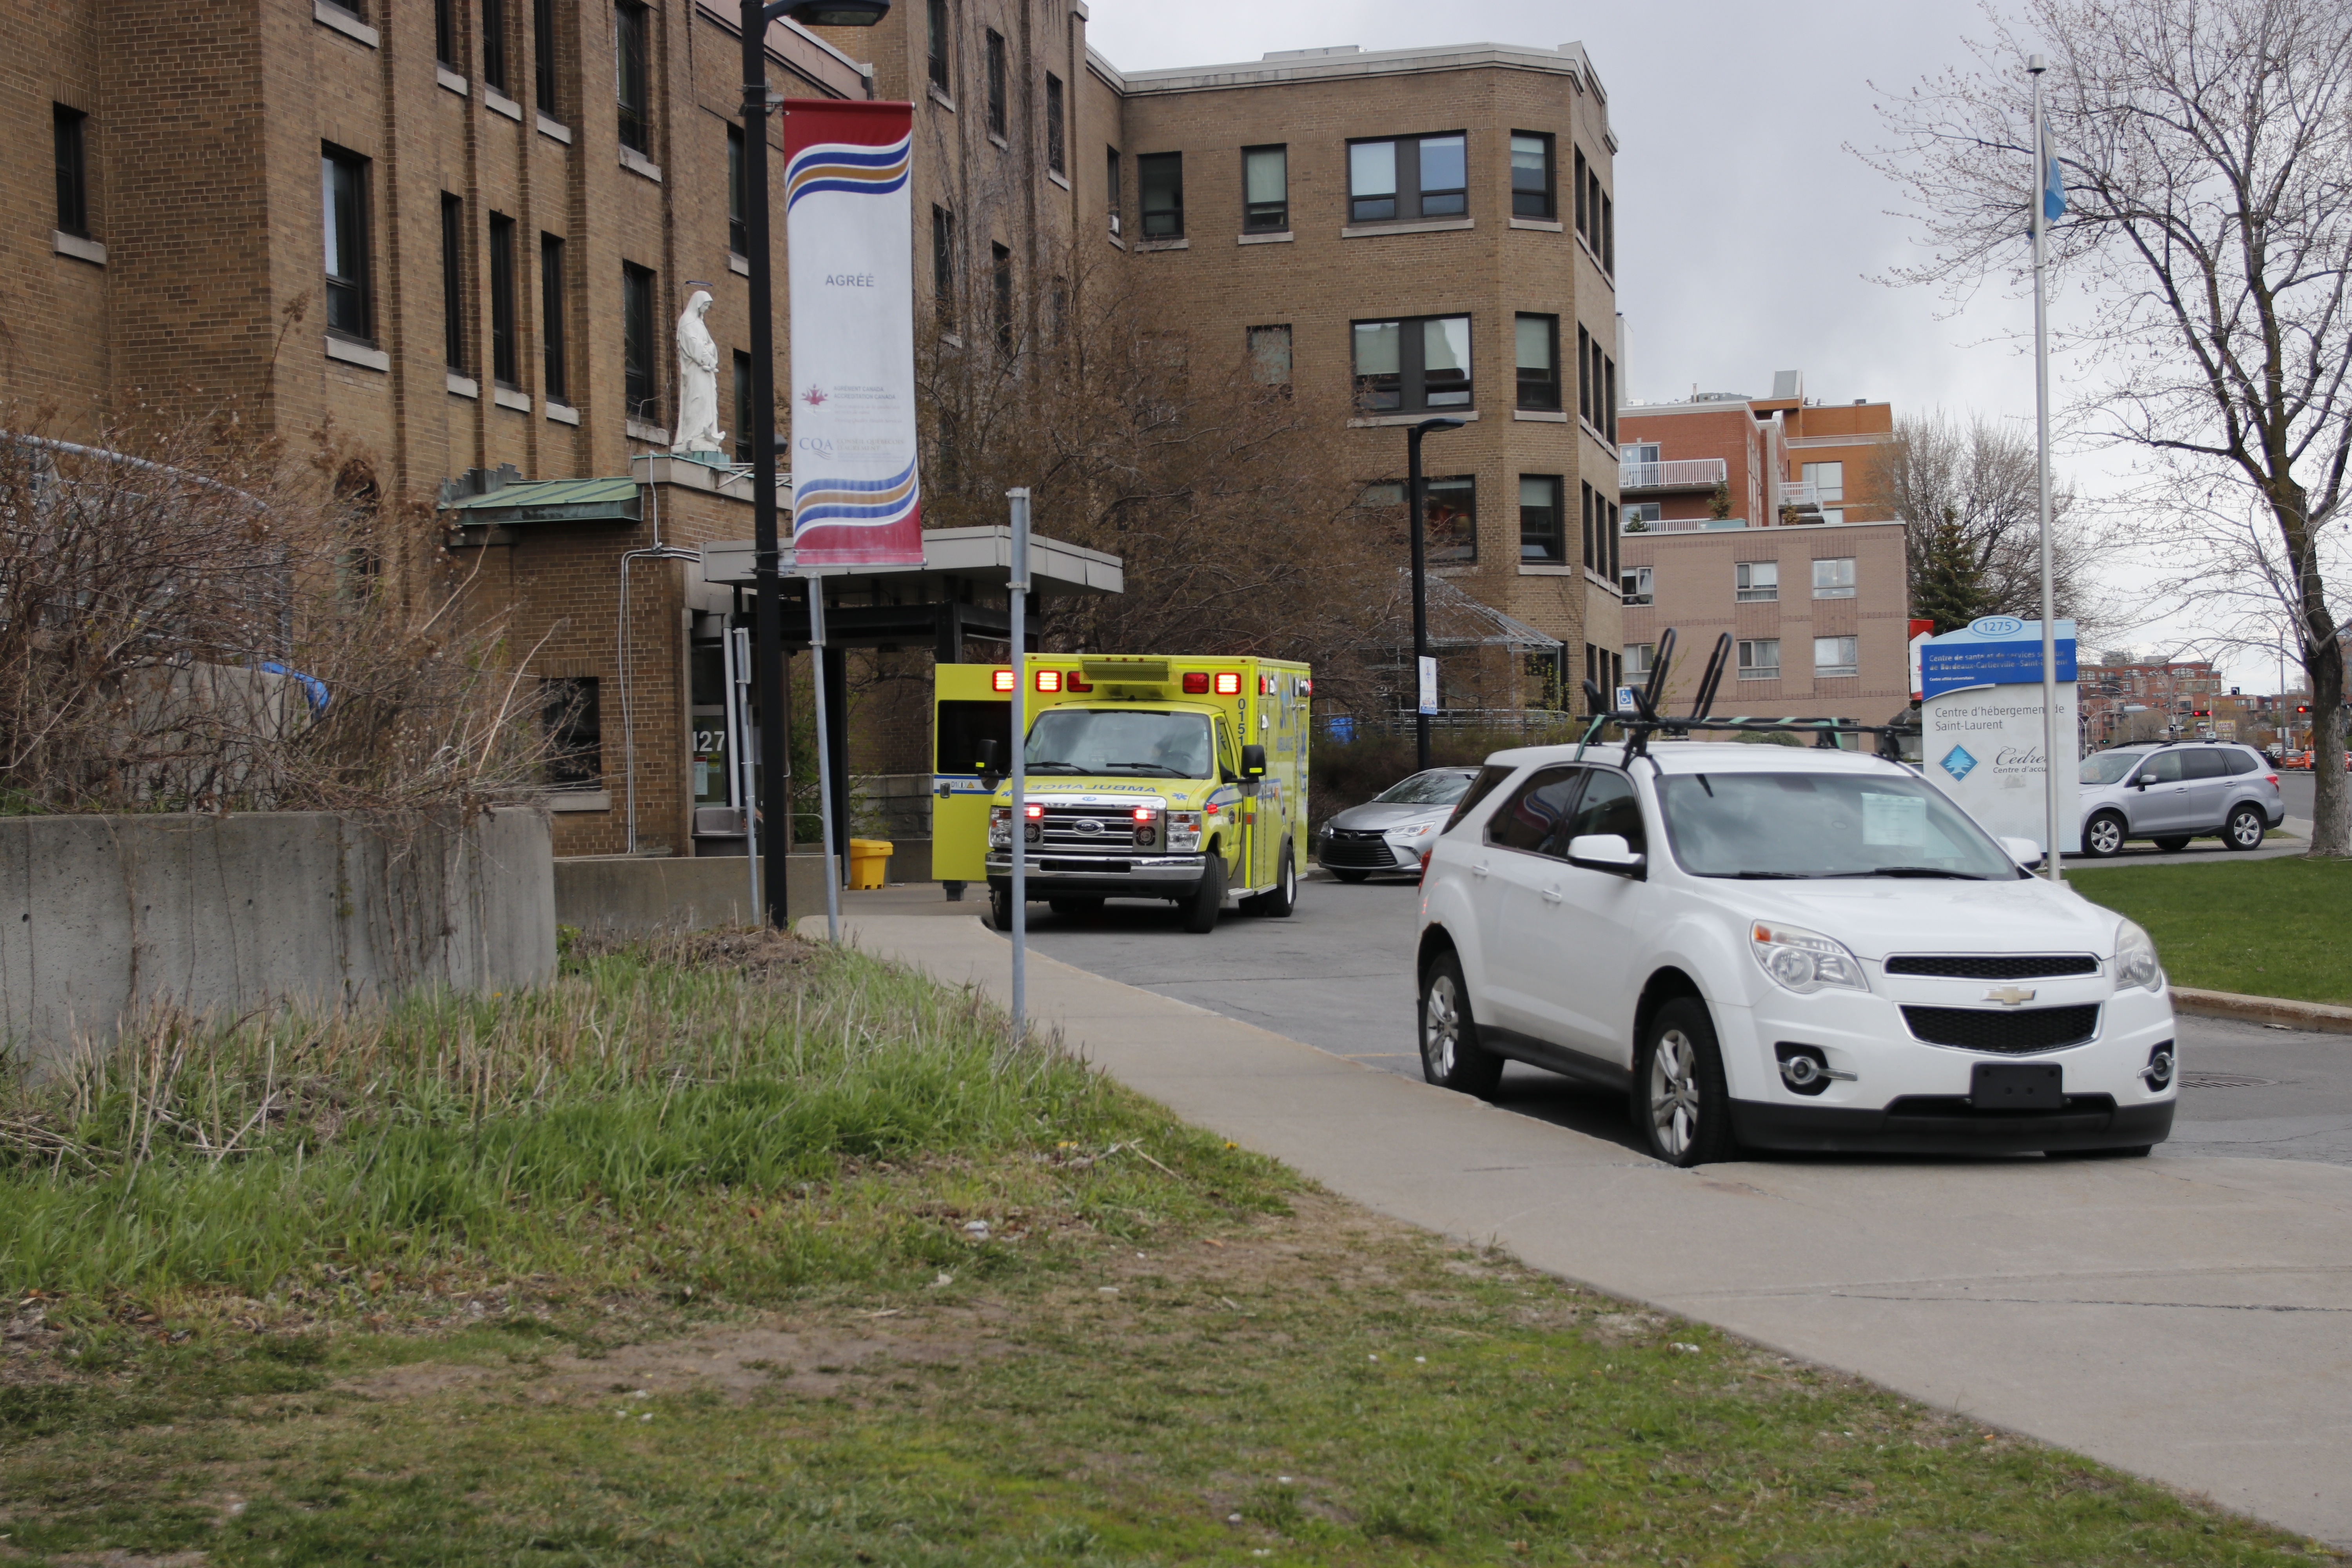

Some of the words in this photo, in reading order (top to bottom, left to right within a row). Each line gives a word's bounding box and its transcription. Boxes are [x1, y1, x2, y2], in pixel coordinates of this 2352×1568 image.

[825, 273, 874, 287] AGRÉÉ
[799, 437, 833, 450] CQA
[1982, 621, 2012, 632] 1275
[1935, 707, 1968, 717] Centre
[1971, 706, 2044, 717] d'hébergemen
[1238, 698, 1246, 746] 0151
[1935, 719, 2003, 731] Saint-Laurent
